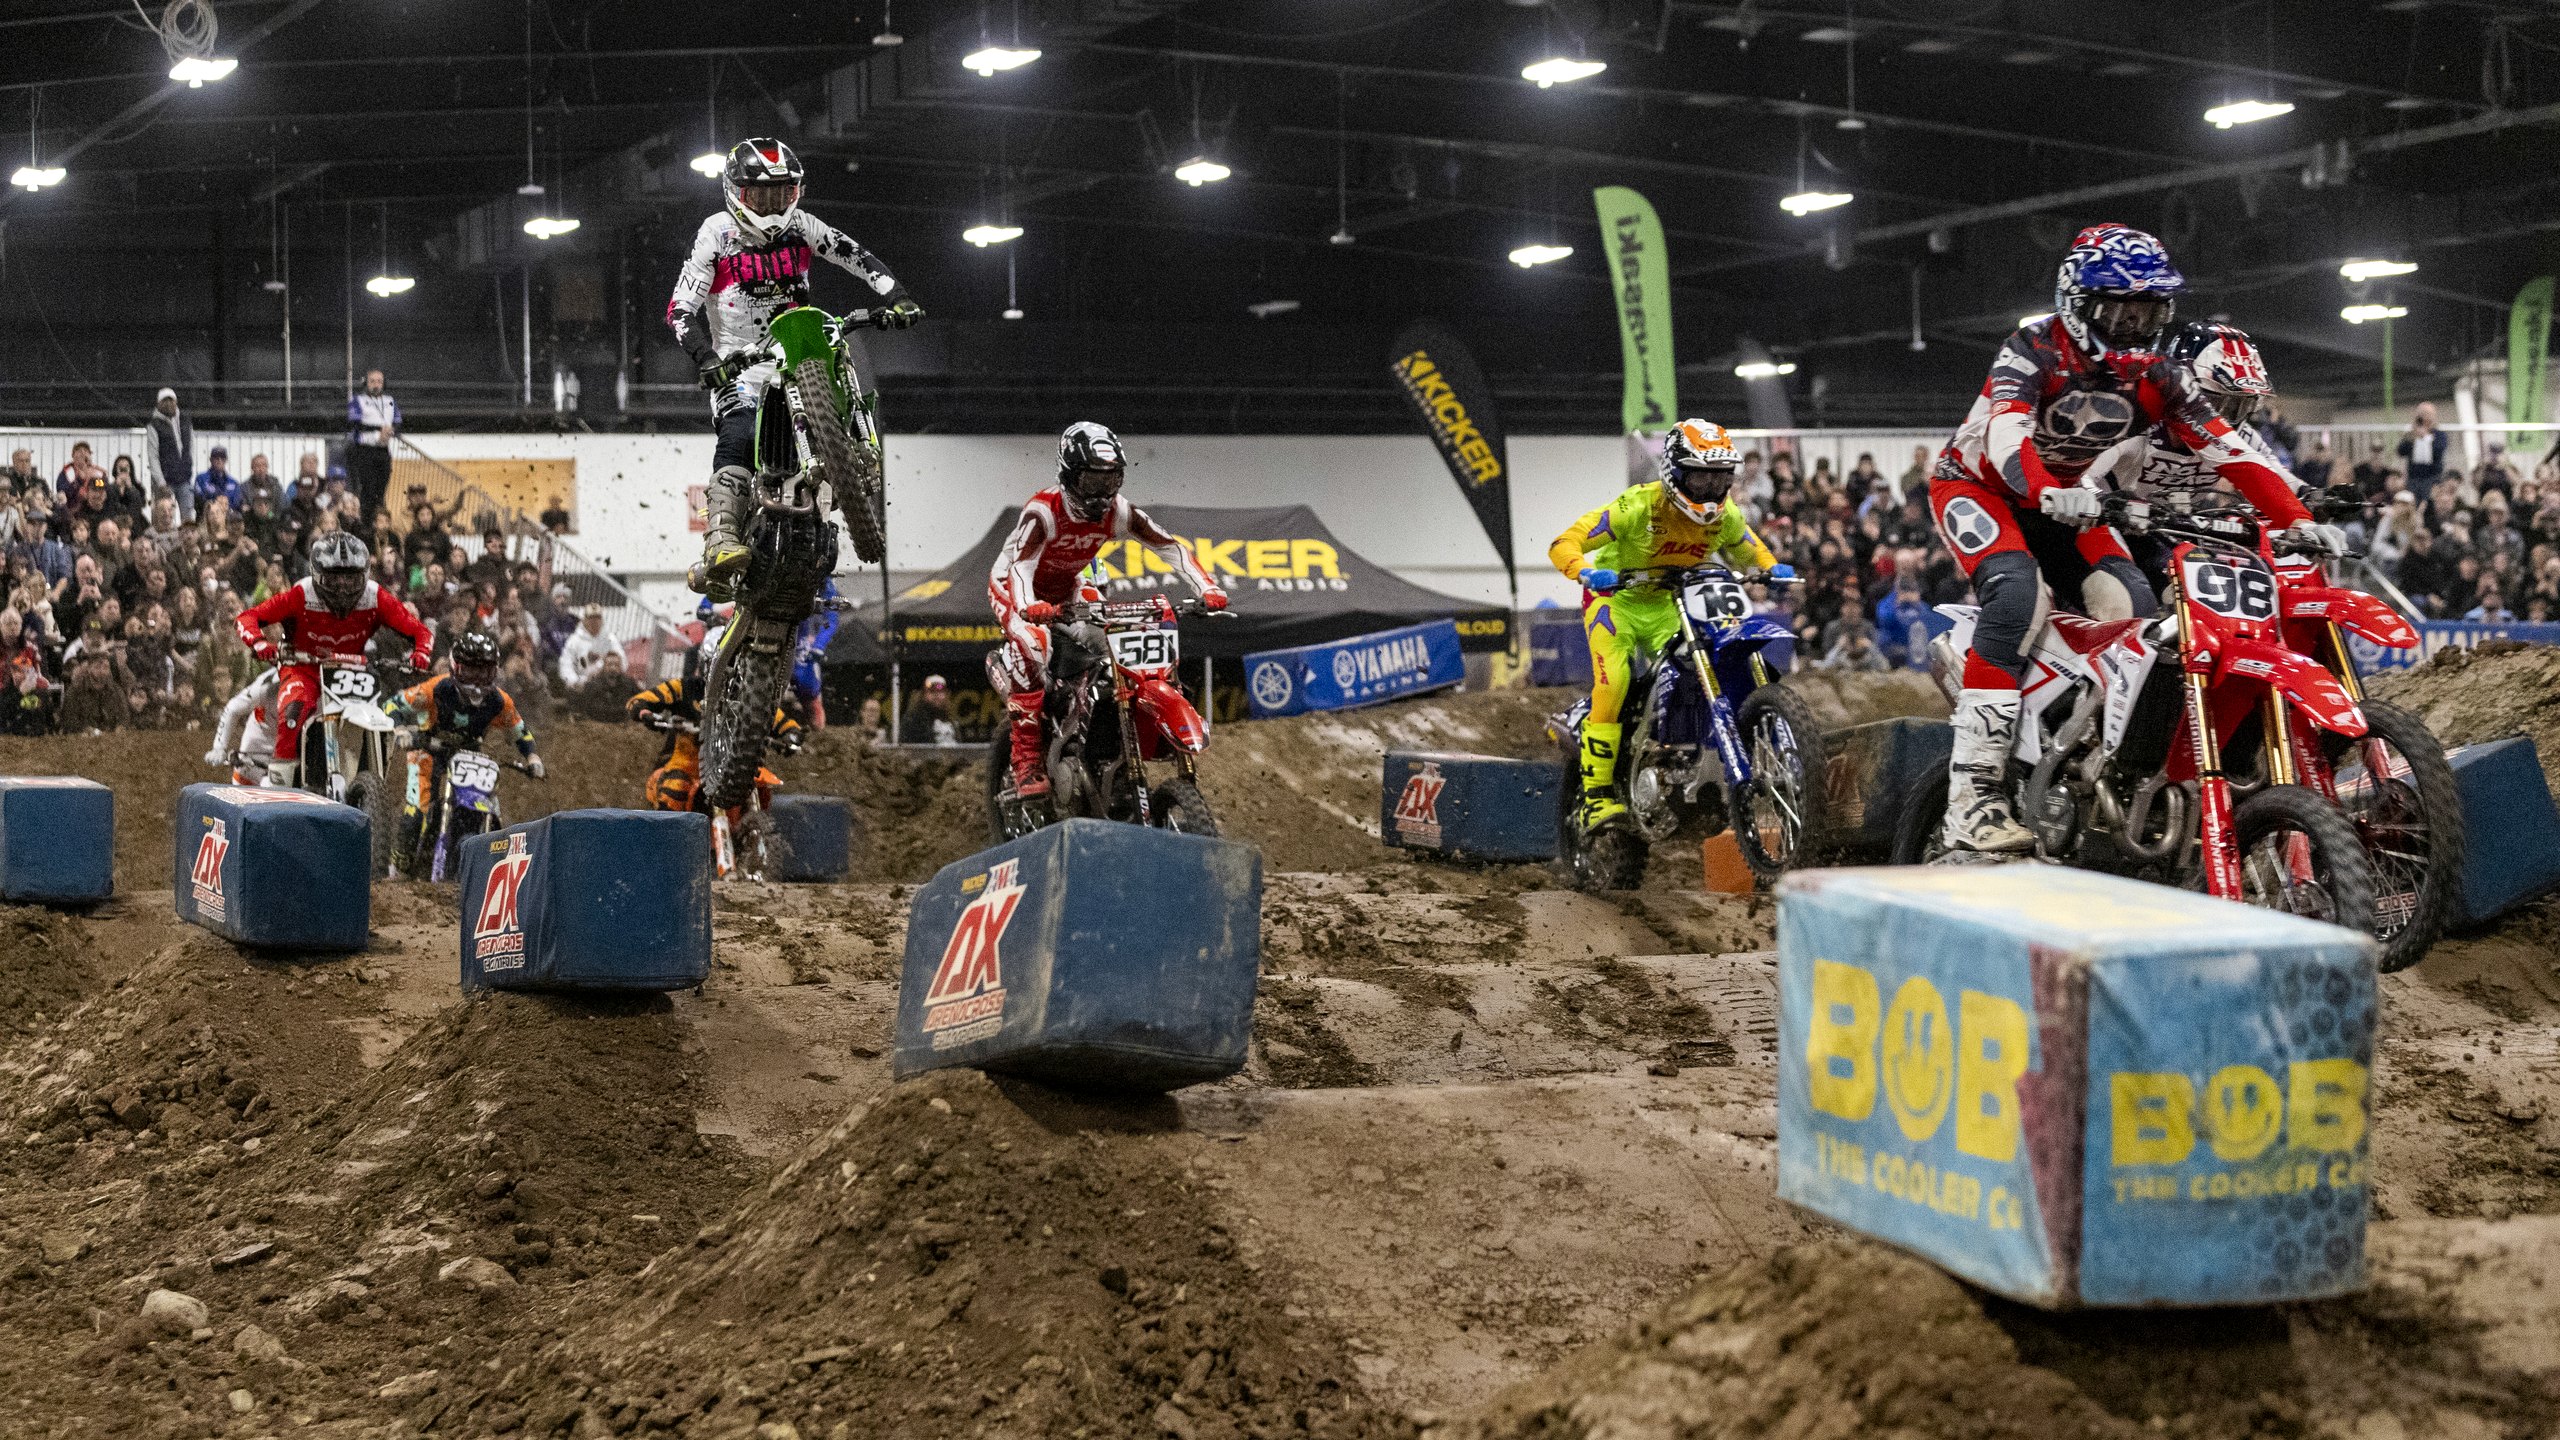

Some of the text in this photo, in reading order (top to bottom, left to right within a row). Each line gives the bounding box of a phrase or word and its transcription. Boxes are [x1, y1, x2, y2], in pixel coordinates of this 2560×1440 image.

[748, 296, 794, 308] Kawasaki
[1412, 365, 1502, 486] KICKER
[1257, 578, 1350, 592] AUDIO
[1694, 583, 1746, 620] 16
[2197, 564, 2274, 619] 98
[1119, 634, 1175, 667] 581
[1354, 634, 1432, 683] YAMAHA
[330, 669, 376, 698] 33
[1344, 671, 1429, 699] RACING
[451, 760, 498, 793] 58
[2205, 822, 2229, 890] DUNLOP
[1806, 958, 2030, 1163] BOB
[2111, 1057, 2369, 1168] BOB
[1815, 1131, 1867, 1186] THE
[1872, 1150, 1982, 1221] COOLER
[2189, 1162, 2319, 1203] COOLER
